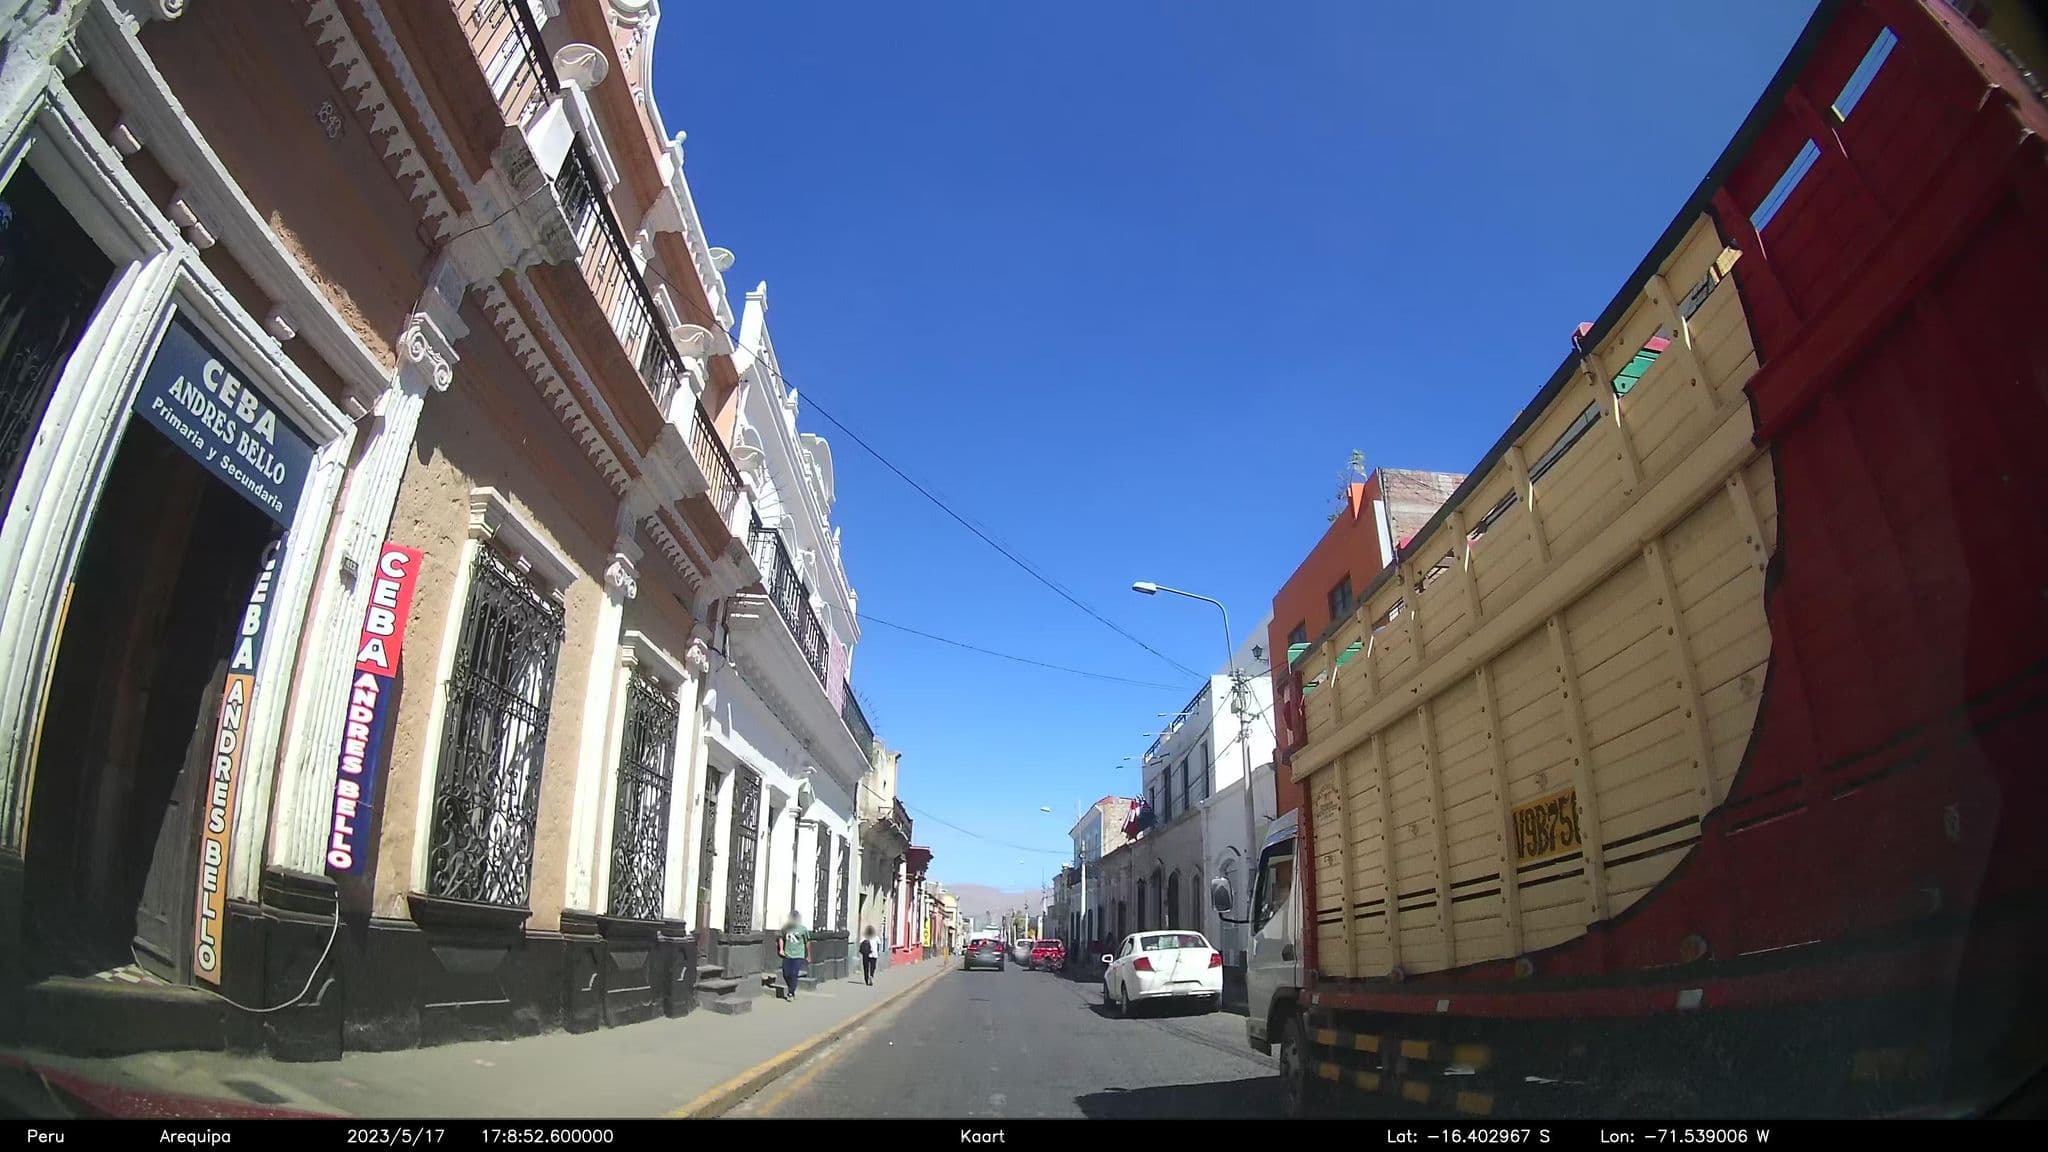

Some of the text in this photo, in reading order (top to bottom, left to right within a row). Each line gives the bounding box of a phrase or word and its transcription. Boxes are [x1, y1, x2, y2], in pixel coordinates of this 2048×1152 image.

[152, 396, 283, 513] Primaria y Secundaria
[169, 375, 285, 485] ANDRES BELLO
[203, 358, 276, 445] CEBA
[231, 538, 281, 670] CEBA
[357, 551, 410, 669] CEBA
[198, 679, 244, 971] ANDRES BELLO
[327, 672, 379, 869] ANDRES BELLO
